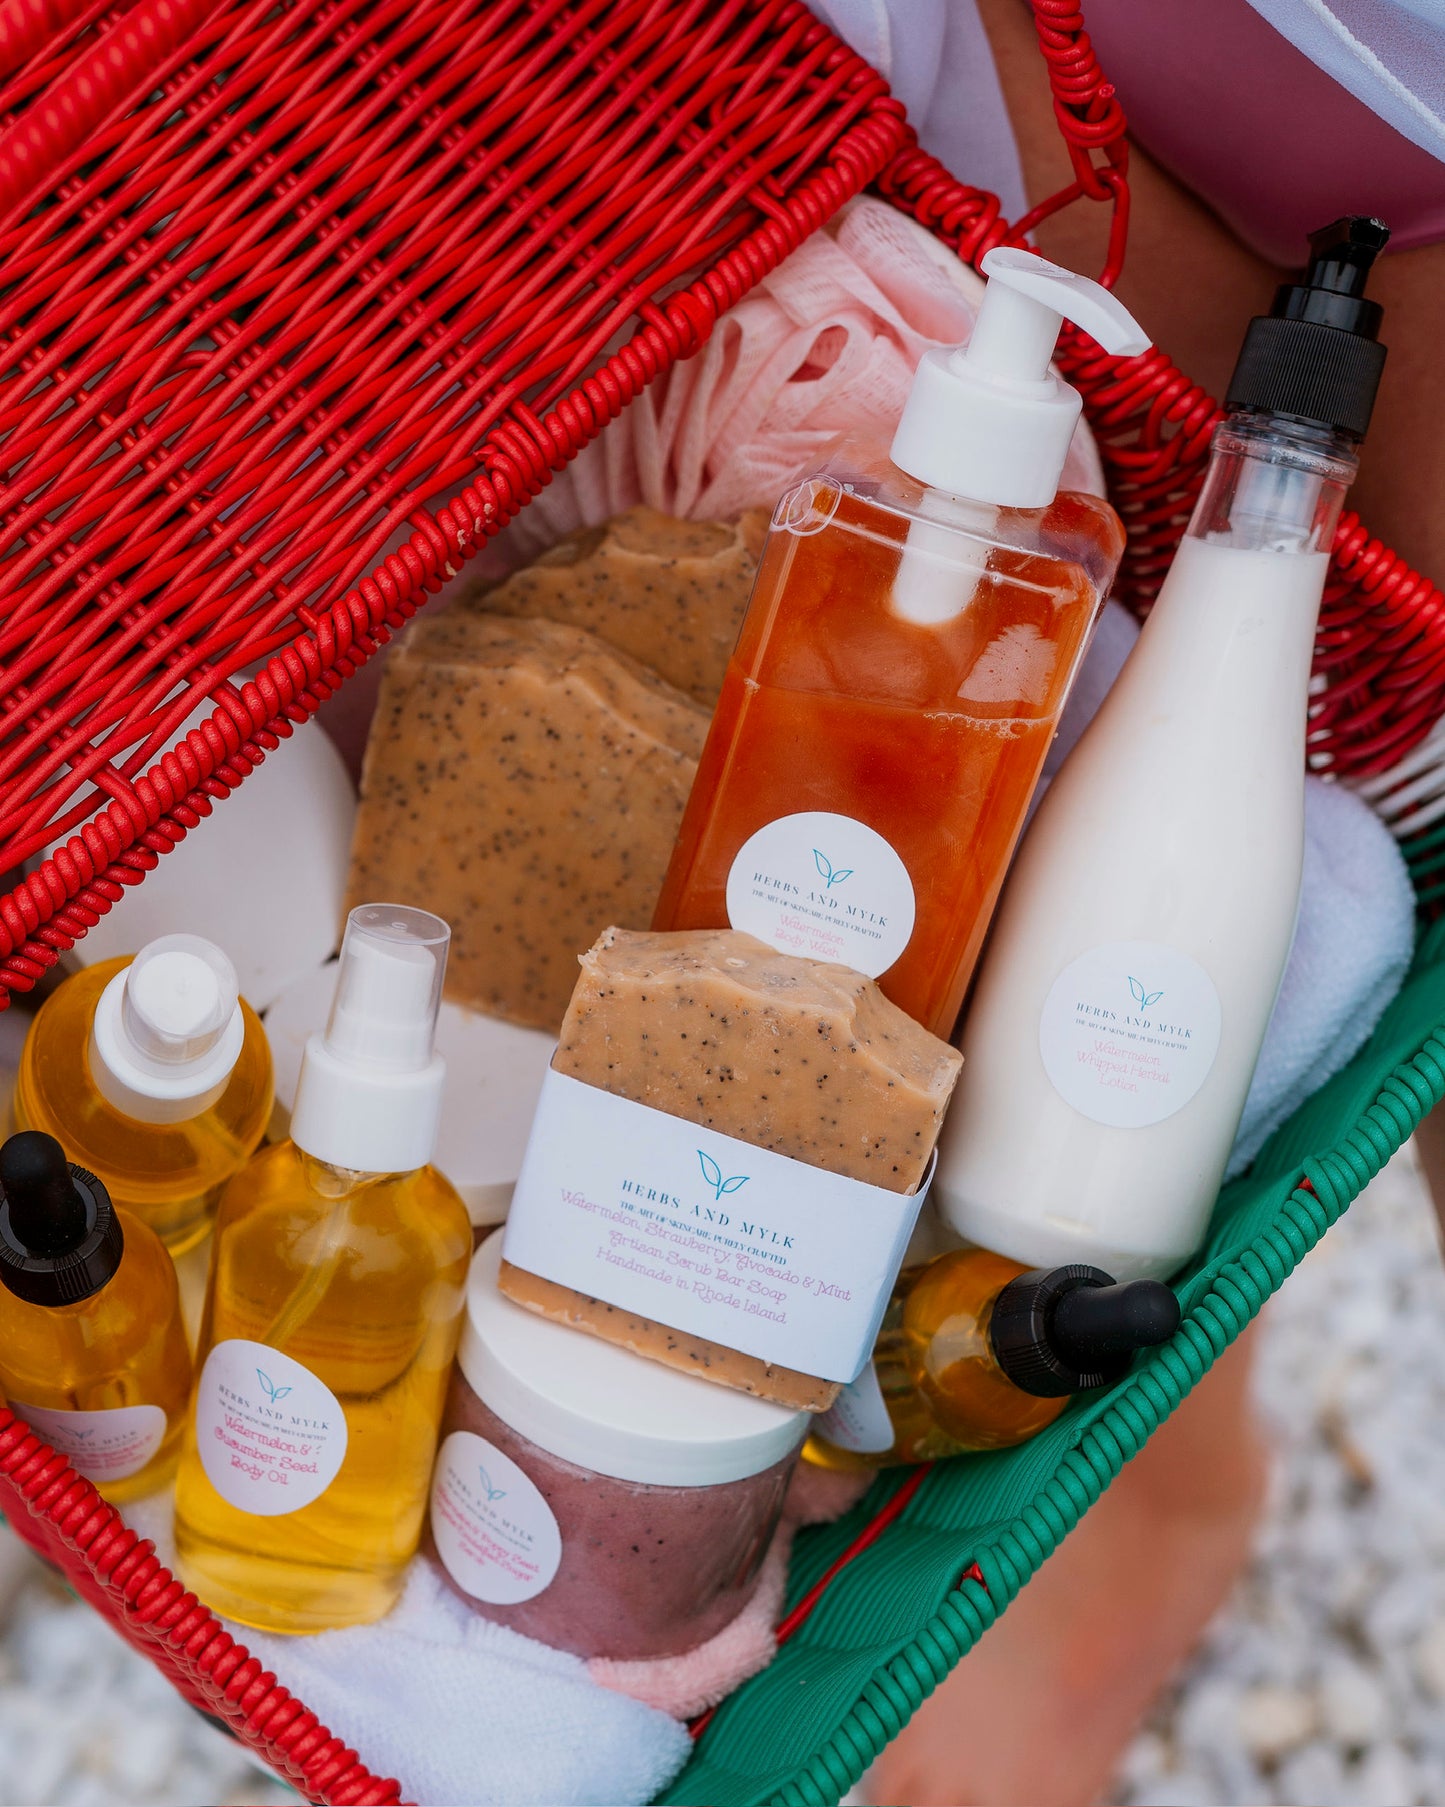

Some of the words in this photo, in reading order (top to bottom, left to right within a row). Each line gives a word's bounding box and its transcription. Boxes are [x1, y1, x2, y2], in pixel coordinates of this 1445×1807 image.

[753, 872, 800, 895] HERBS
[806, 891, 838, 909] AND
[845, 905, 889, 927] MYLK
[774, 928, 804, 947] Body
[809, 939, 840, 959] Wash
[780, 914, 846, 946] Watermelon
[1076, 1002, 1117, 1020] HERBS
[1123, 1016, 1151, 1029] AND
[1157, 1023, 1193, 1039] MYLK
[1076, 1049, 1128, 1073] Whipped
[1130, 1063, 1171, 1084] Herbal
[1094, 1039, 1161, 1066] Watermelon
[1099, 1072, 1139, 1093] Lotion
[619, 1200, 635, 1212] THE
[636, 1204, 654, 1219] ART
[654, 1213, 669, 1225] OF
[712, 1233, 747, 1252] PURELY
[746, 1244, 787, 1265] CRAFTED
[621, 1179, 681, 1209] HERBS
[689, 1204, 730, 1227] AND
[739, 1221, 796, 1249] MYLK
[596, 1246, 673, 1286] Handmade
[676, 1273, 689, 1290] in
[692, 1279, 742, 1310] Rhode
[742, 1299, 788, 1325] Island
[608, 1229, 665, 1260] Artisan
[665, 1250, 713, 1277] Scrub
[716, 1268, 746, 1288] Bar
[746, 1279, 788, 1306] Soap
[735, 1251, 801, 1285] Avocado
[802, 1276, 814, 1289] &
[814, 1279, 852, 1302] Mint
[218, 1383, 250, 1408] HERBS
[257, 1405, 283, 1421] AND
[290, 1416, 330, 1430] MYLK
[214, 1426, 276, 1465] Cucumber
[278, 1456, 319, 1475] Seed
[224, 1413, 297, 1455] Watermelon
[299, 1444, 312, 1456] &
[230, 1454, 265, 1481] Body
[267, 1469, 289, 1485] Oil
[502, 1518, 534, 1543] MYLK
